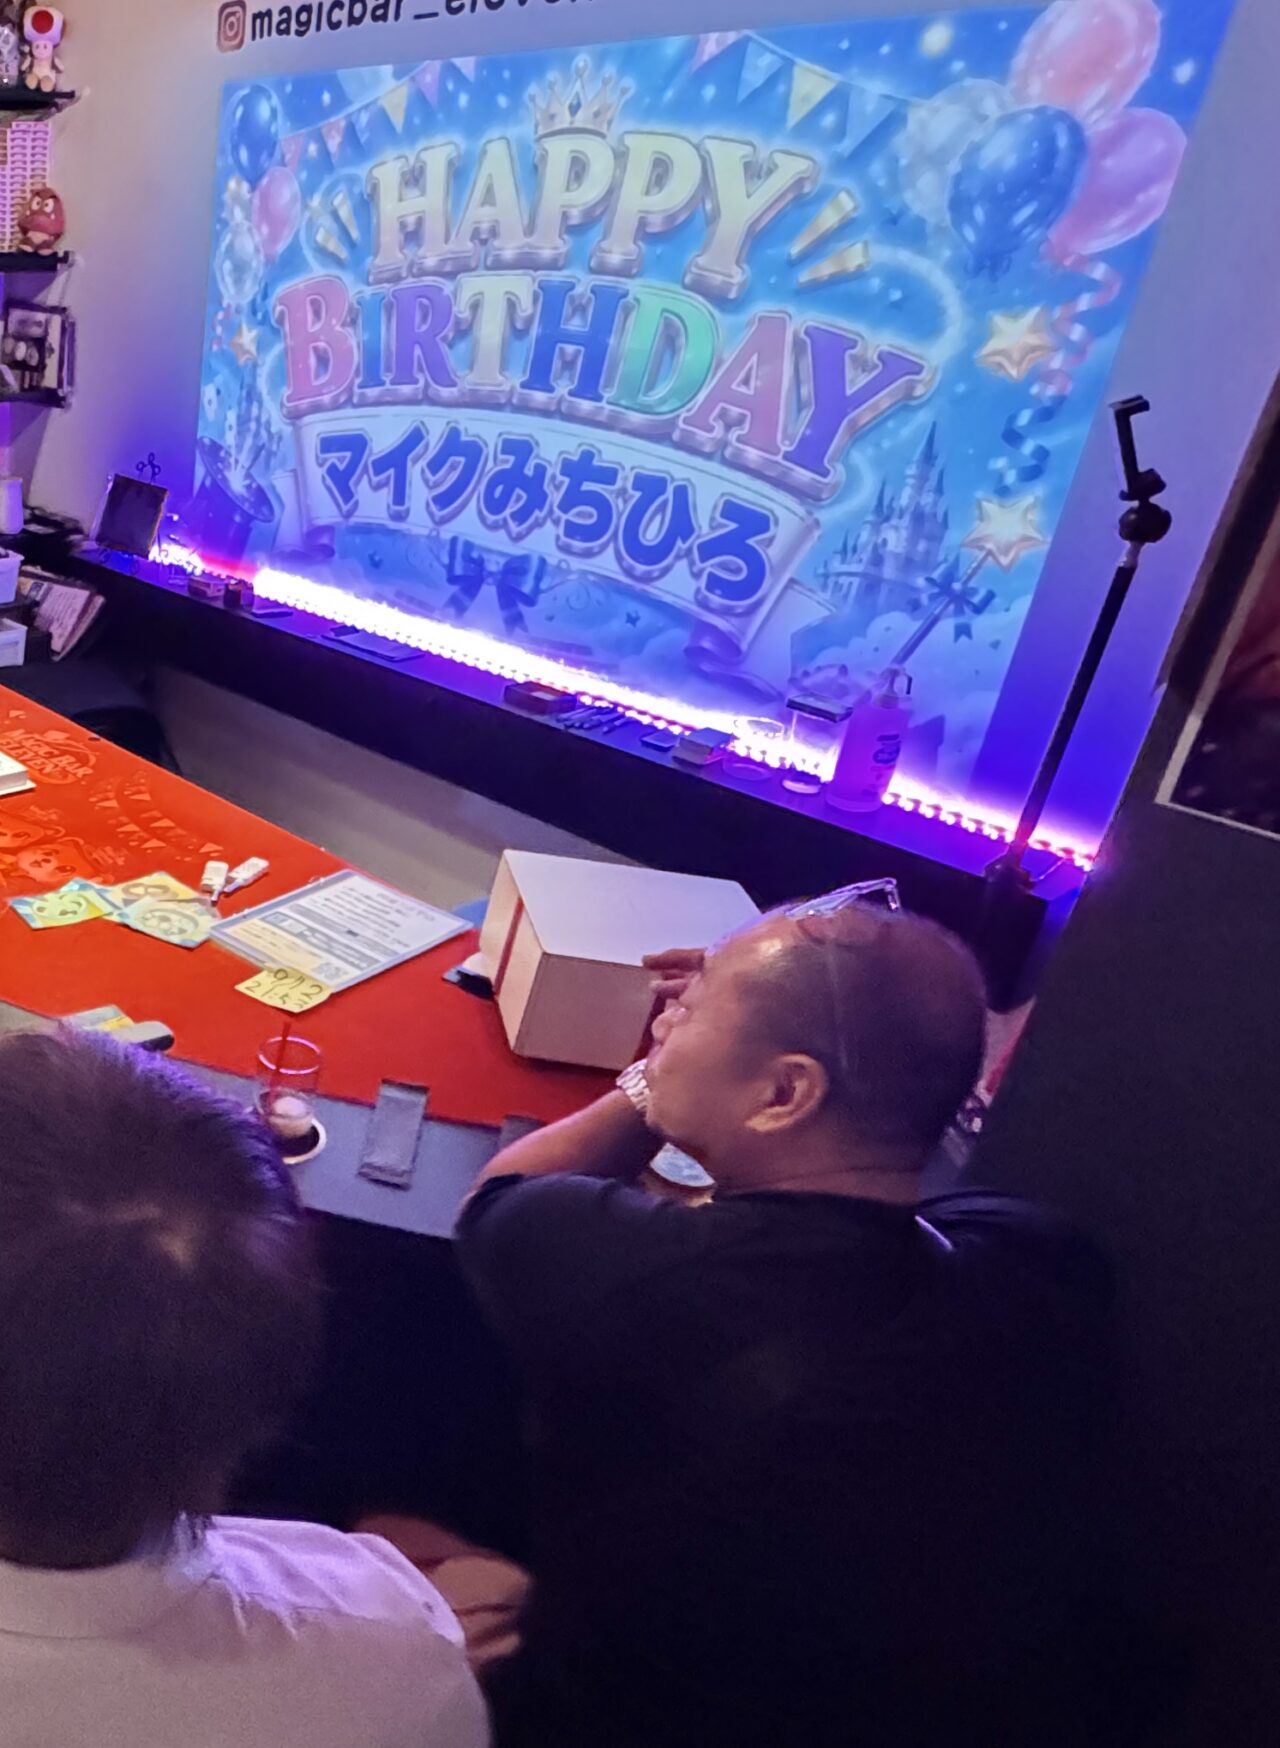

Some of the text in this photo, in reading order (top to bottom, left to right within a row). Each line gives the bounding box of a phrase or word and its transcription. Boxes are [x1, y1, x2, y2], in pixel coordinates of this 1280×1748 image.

[250, 0, 593, 41] magicbar_e
[367, 131, 816, 299] HAPPY
[275, 273, 929, 498] BIRTHDAY
[316, 424, 776, 602] マイクみちひろ
